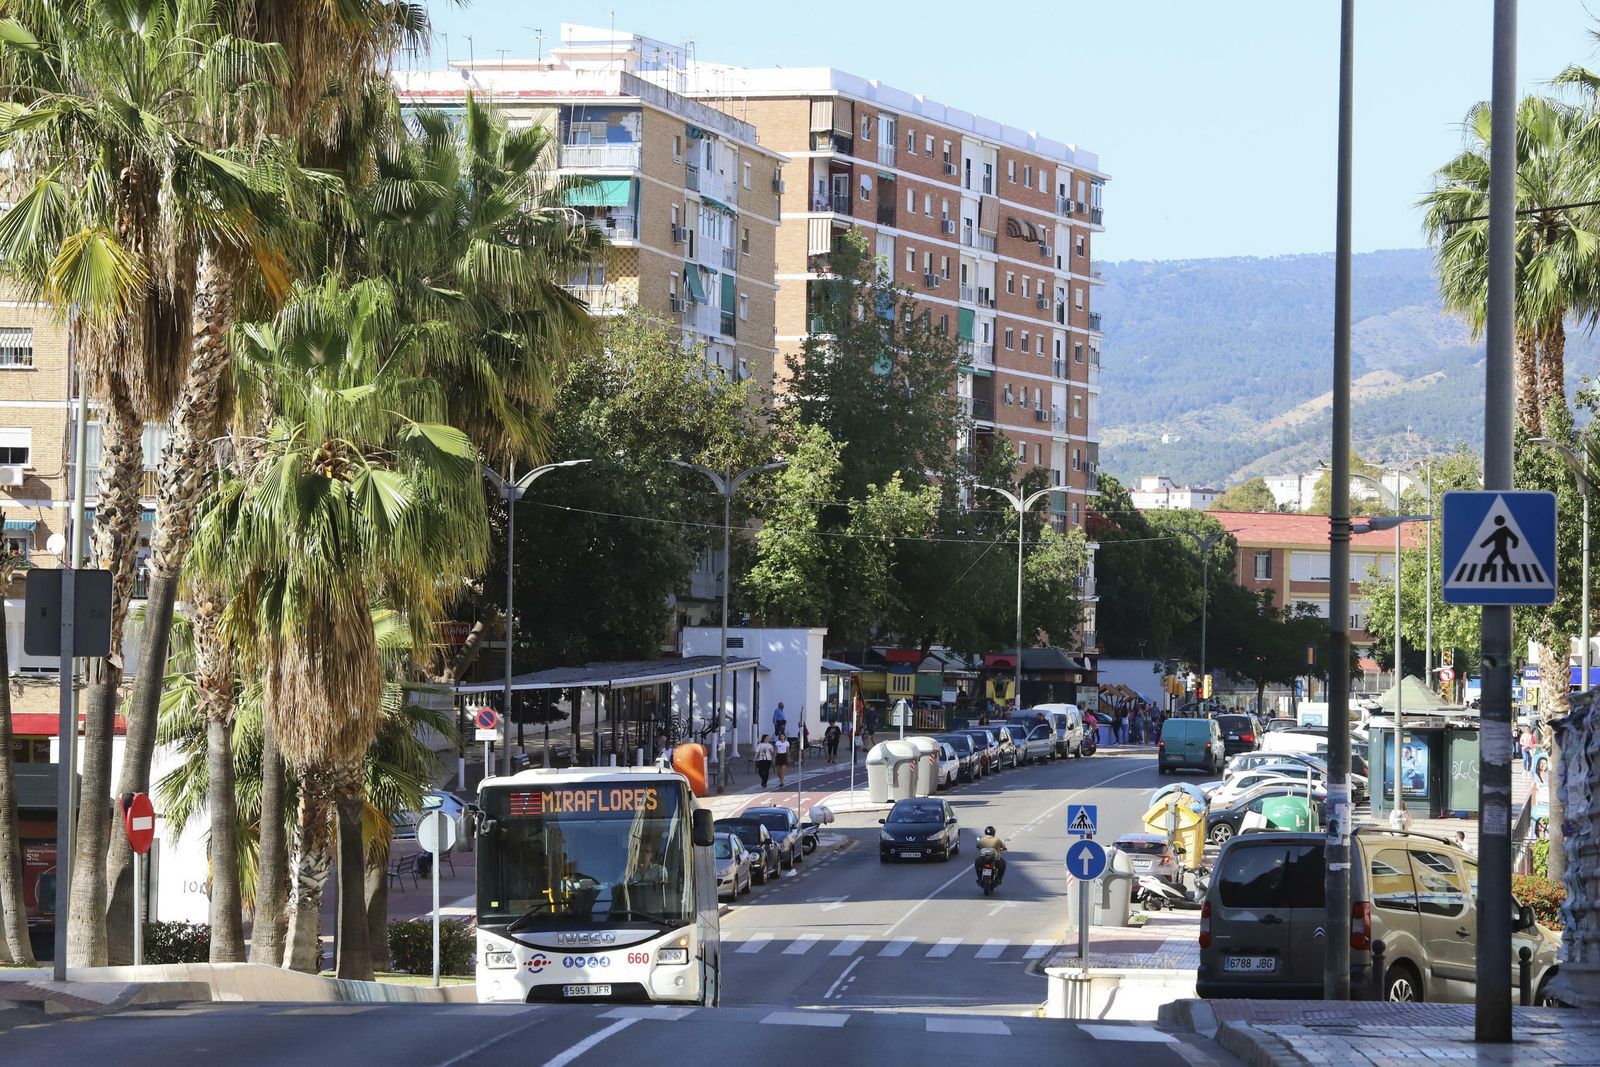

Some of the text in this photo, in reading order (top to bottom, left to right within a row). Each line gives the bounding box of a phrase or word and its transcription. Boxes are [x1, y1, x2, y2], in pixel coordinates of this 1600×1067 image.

[541, 789, 658, 813] MIRAFLORES
[557, 932, 616, 945] IVECO
[627, 952, 650, 965] 660
[1230, 958, 1272, 968] 6788 JBG
[569, 985, 610, 995] 5951 JFR
